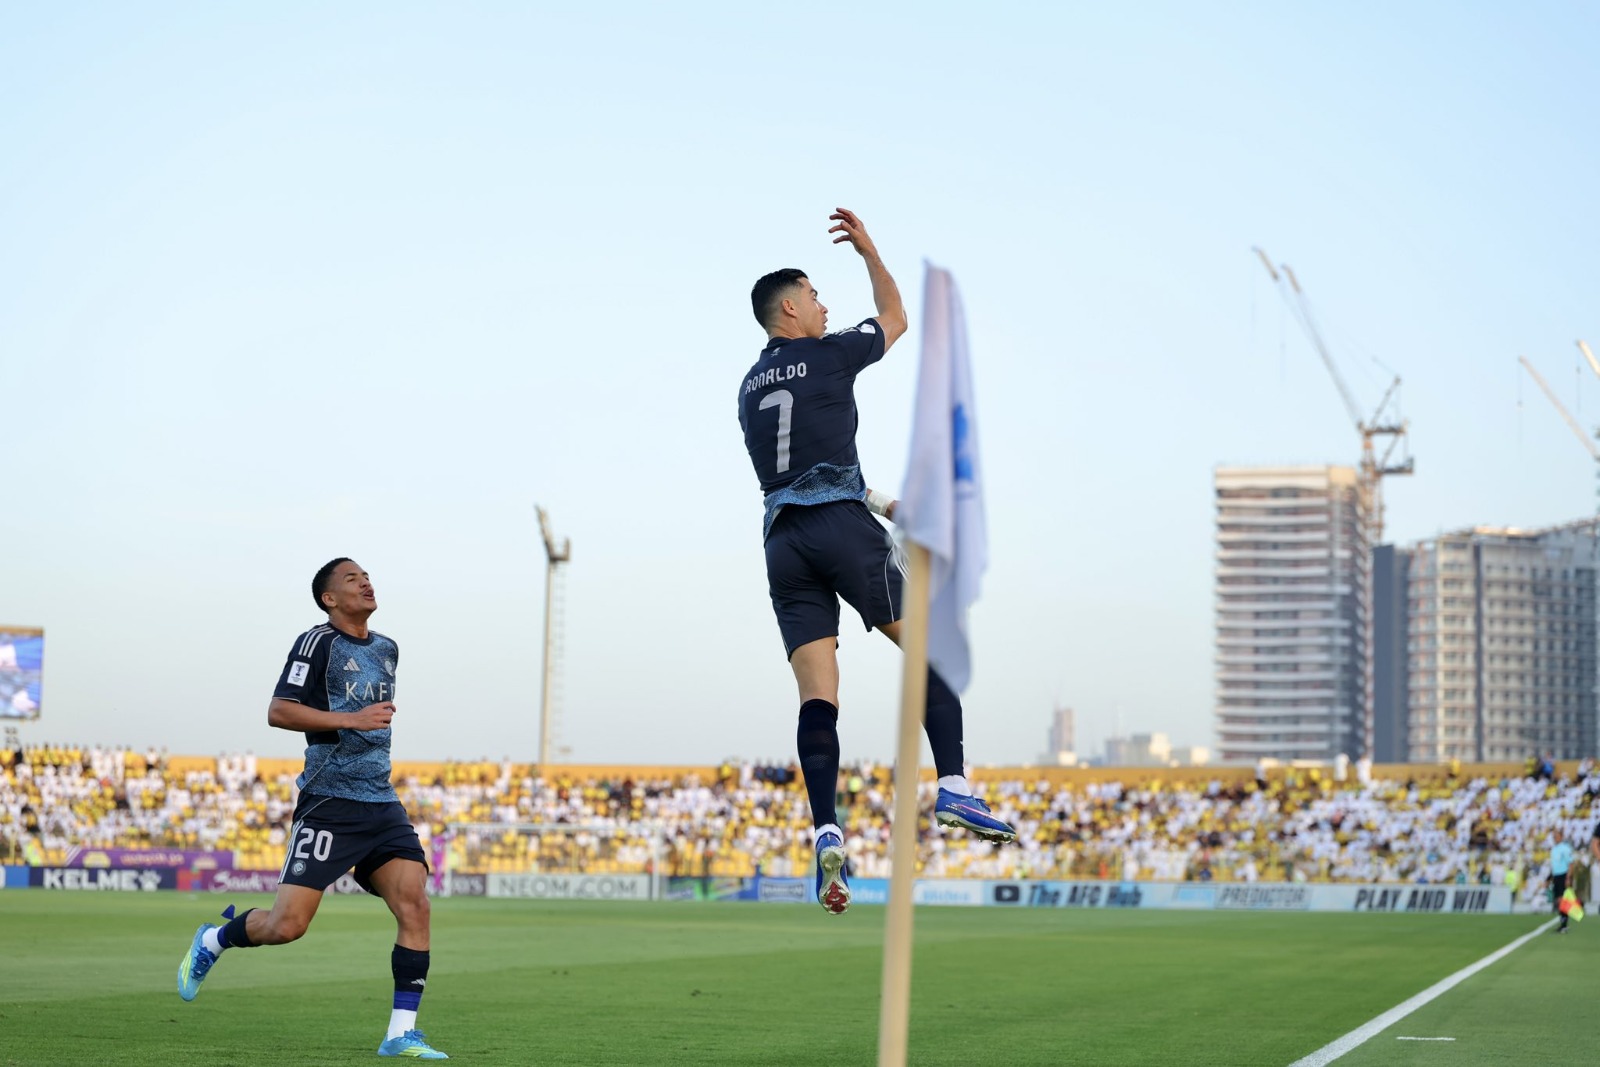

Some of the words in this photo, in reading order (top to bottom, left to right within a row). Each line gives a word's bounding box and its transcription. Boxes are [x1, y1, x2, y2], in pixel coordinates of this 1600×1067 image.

[745, 362, 807, 395] RONALDO
[758, 389, 794, 474] 7
[294, 827, 334, 862] 20
[43, 868, 140, 891] KELME
[499, 877, 639, 897] NEOM.COM
[1028, 884, 1061, 907] The
[1066, 884, 1102, 907] AFC
[1354, 888, 1402, 911] PLAY
[1406, 888, 1447, 911] AND
[1453, 889, 1490, 912] WIN
